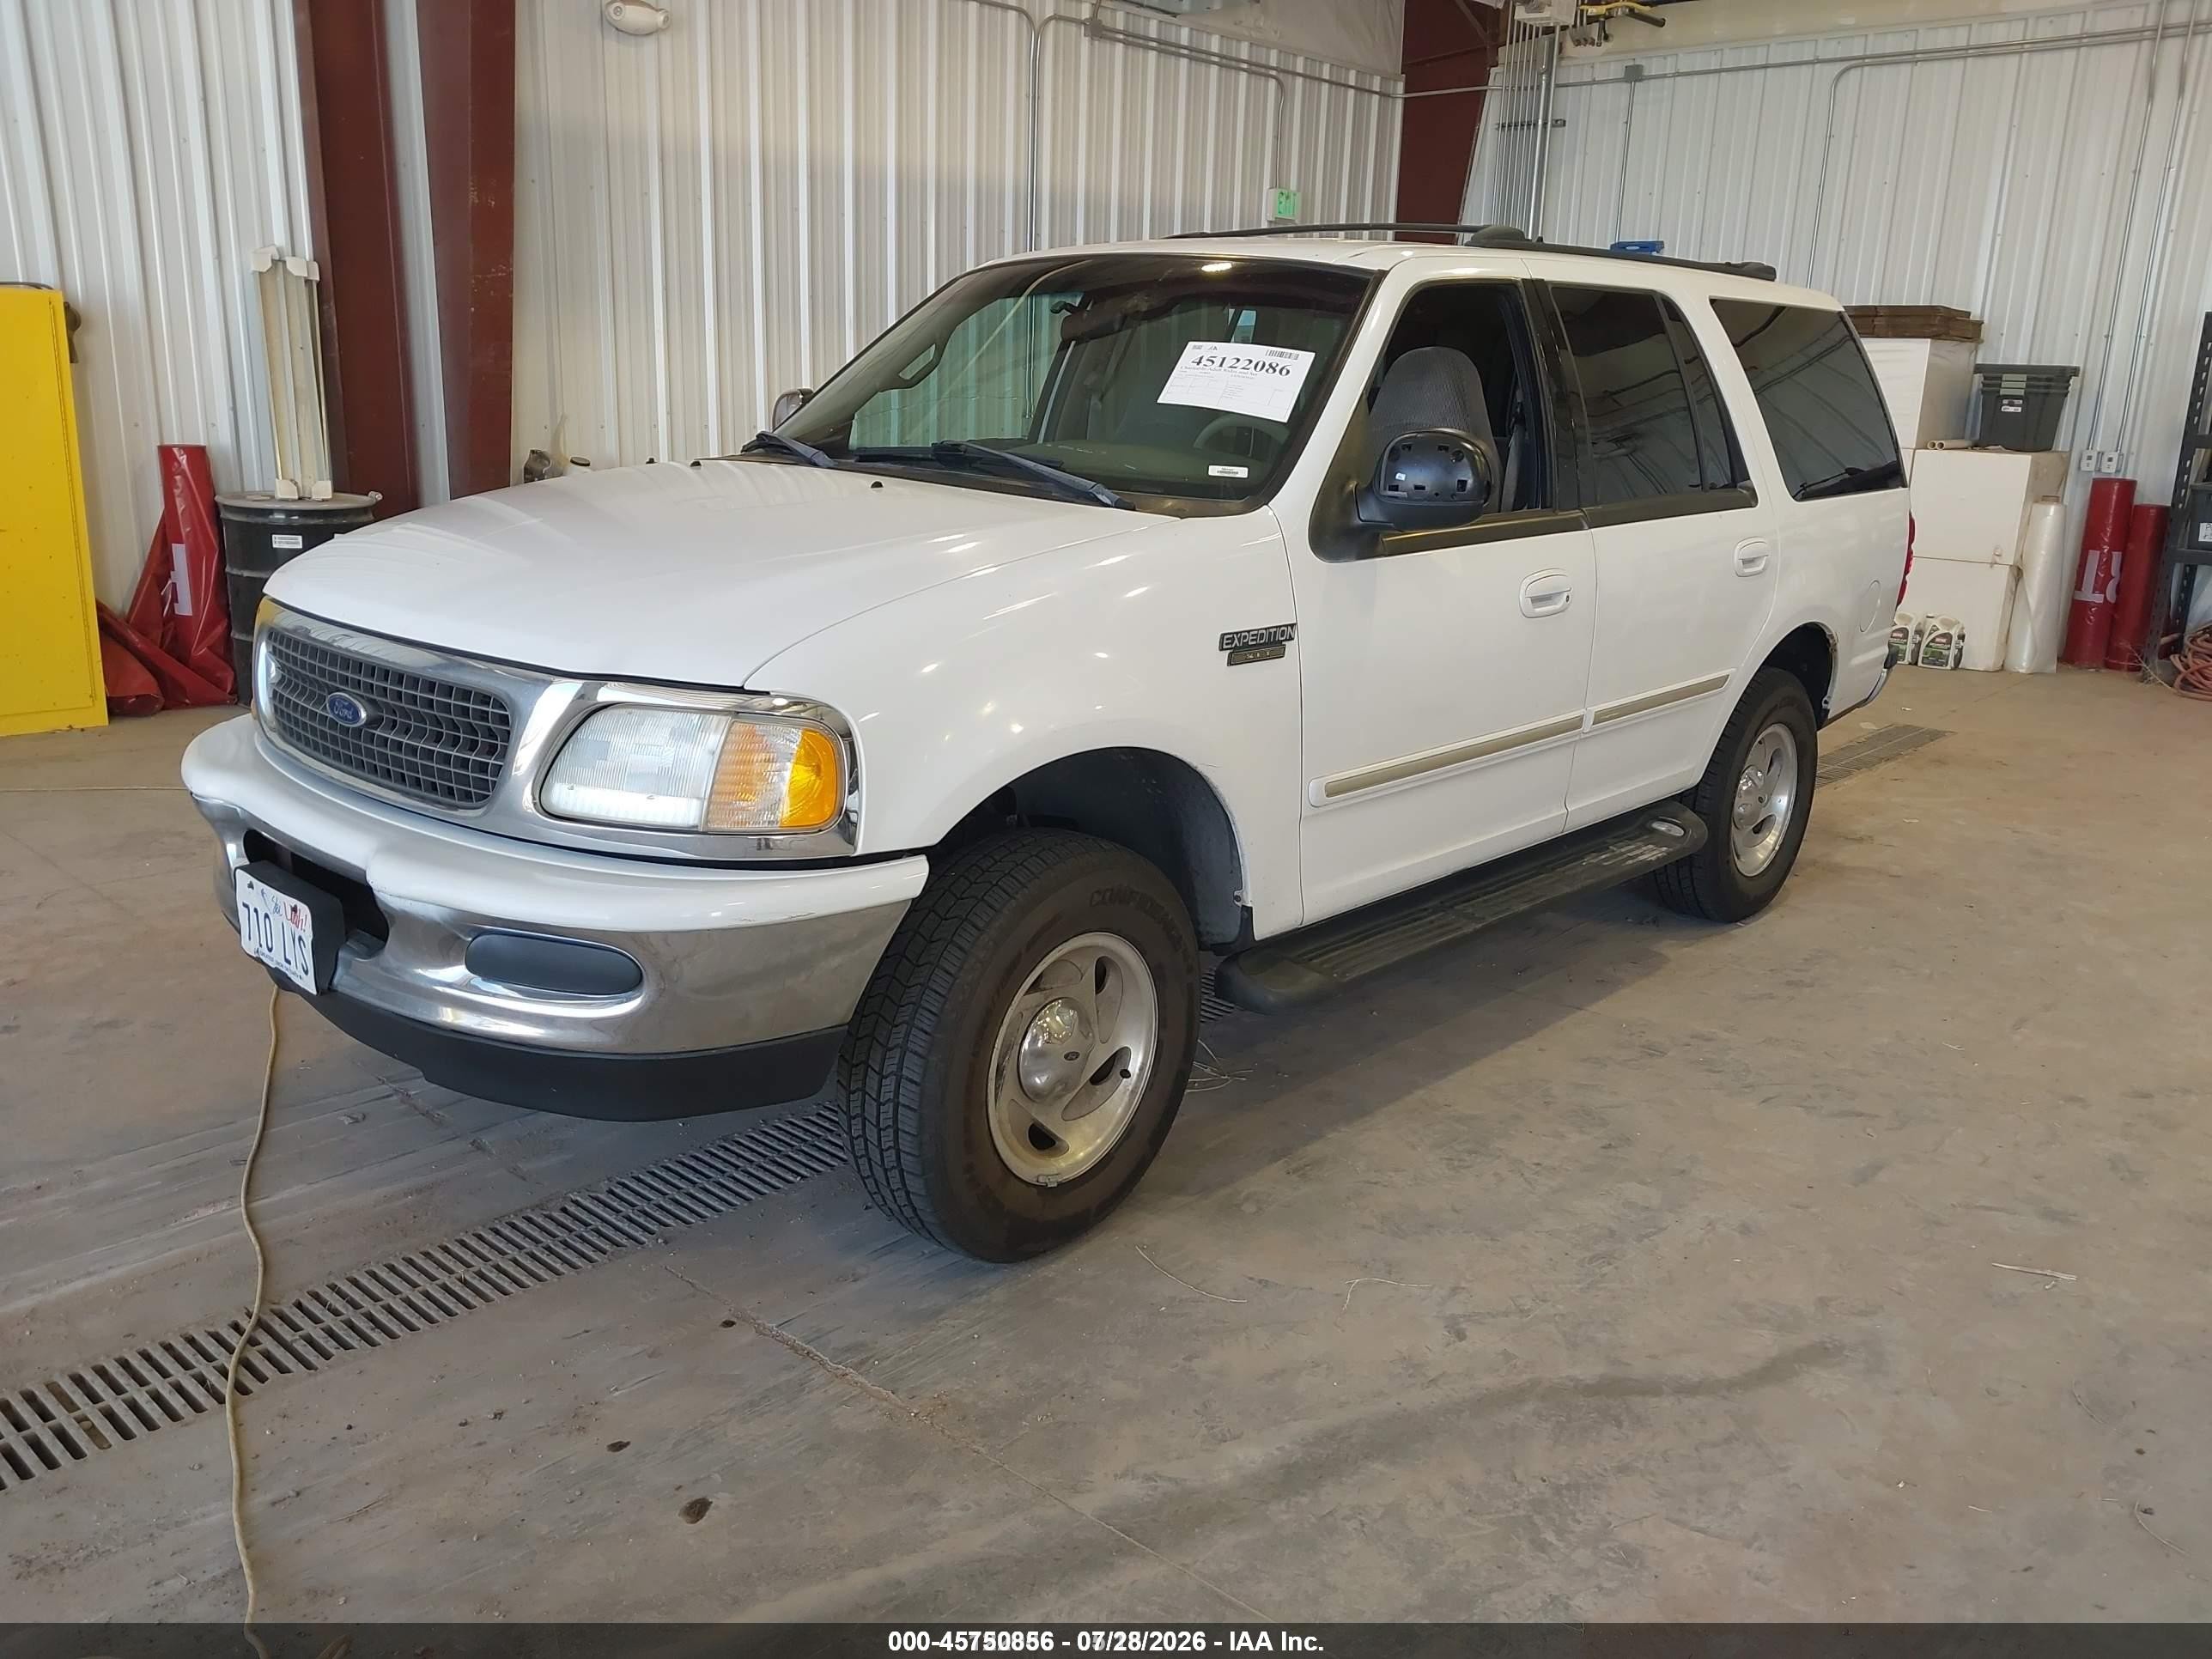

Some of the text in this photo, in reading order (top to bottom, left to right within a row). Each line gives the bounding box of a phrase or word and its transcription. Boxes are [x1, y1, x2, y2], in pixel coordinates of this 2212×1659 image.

[1191, 355, 1291, 377] 45122086
[1222, 625, 1296, 649] EXPEDITION
[242, 901, 273, 953] 710
[282, 921, 309, 976] LYS
